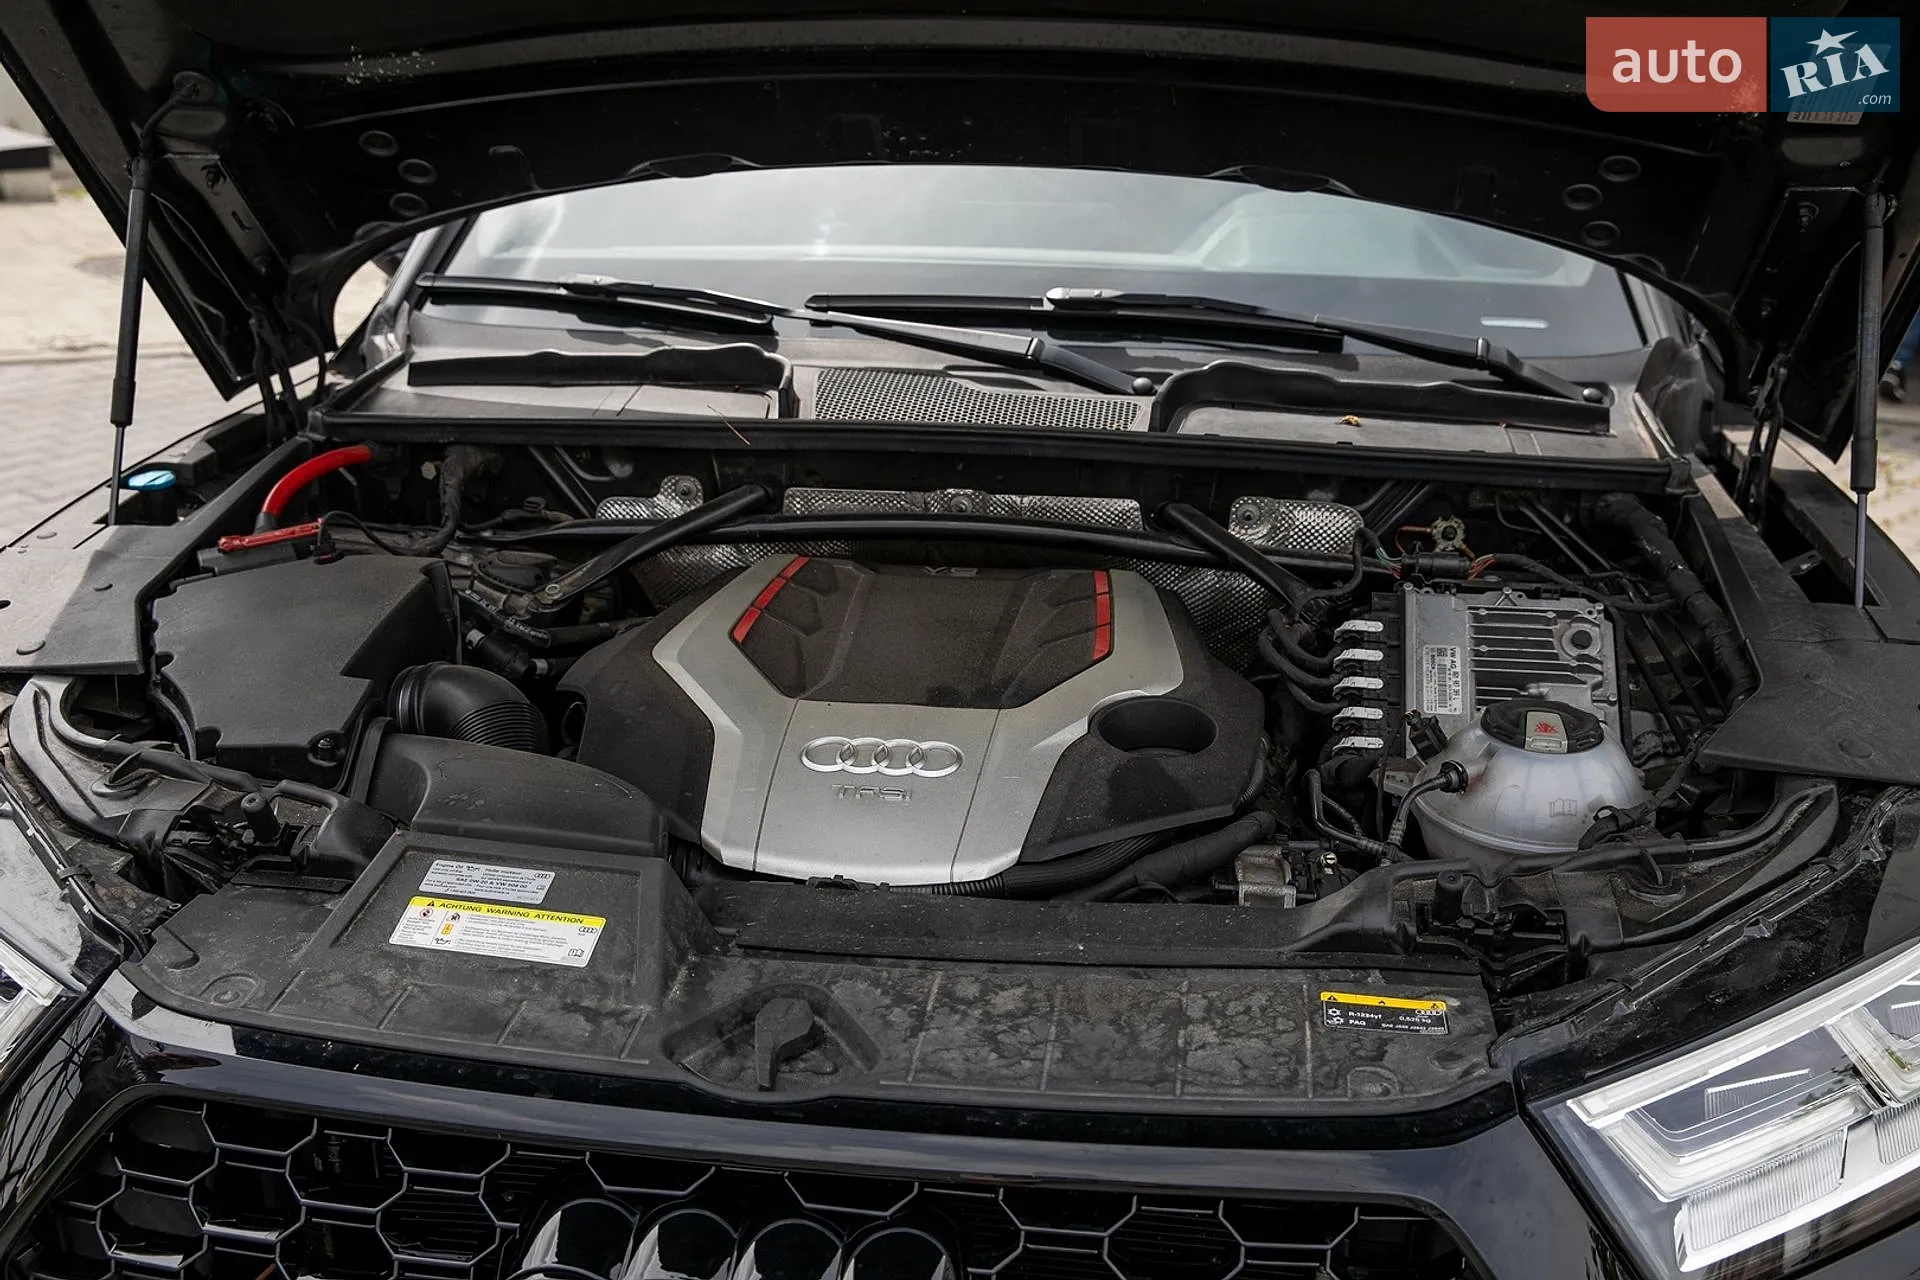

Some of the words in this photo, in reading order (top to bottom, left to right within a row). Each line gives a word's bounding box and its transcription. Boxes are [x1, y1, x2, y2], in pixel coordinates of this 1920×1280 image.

[831, 784, 913, 802] TFSI
[438, 902, 482, 913] ACHTUNG
[486, 908, 530, 918] WARNING
[534, 913, 584, 924] ATTENTION
